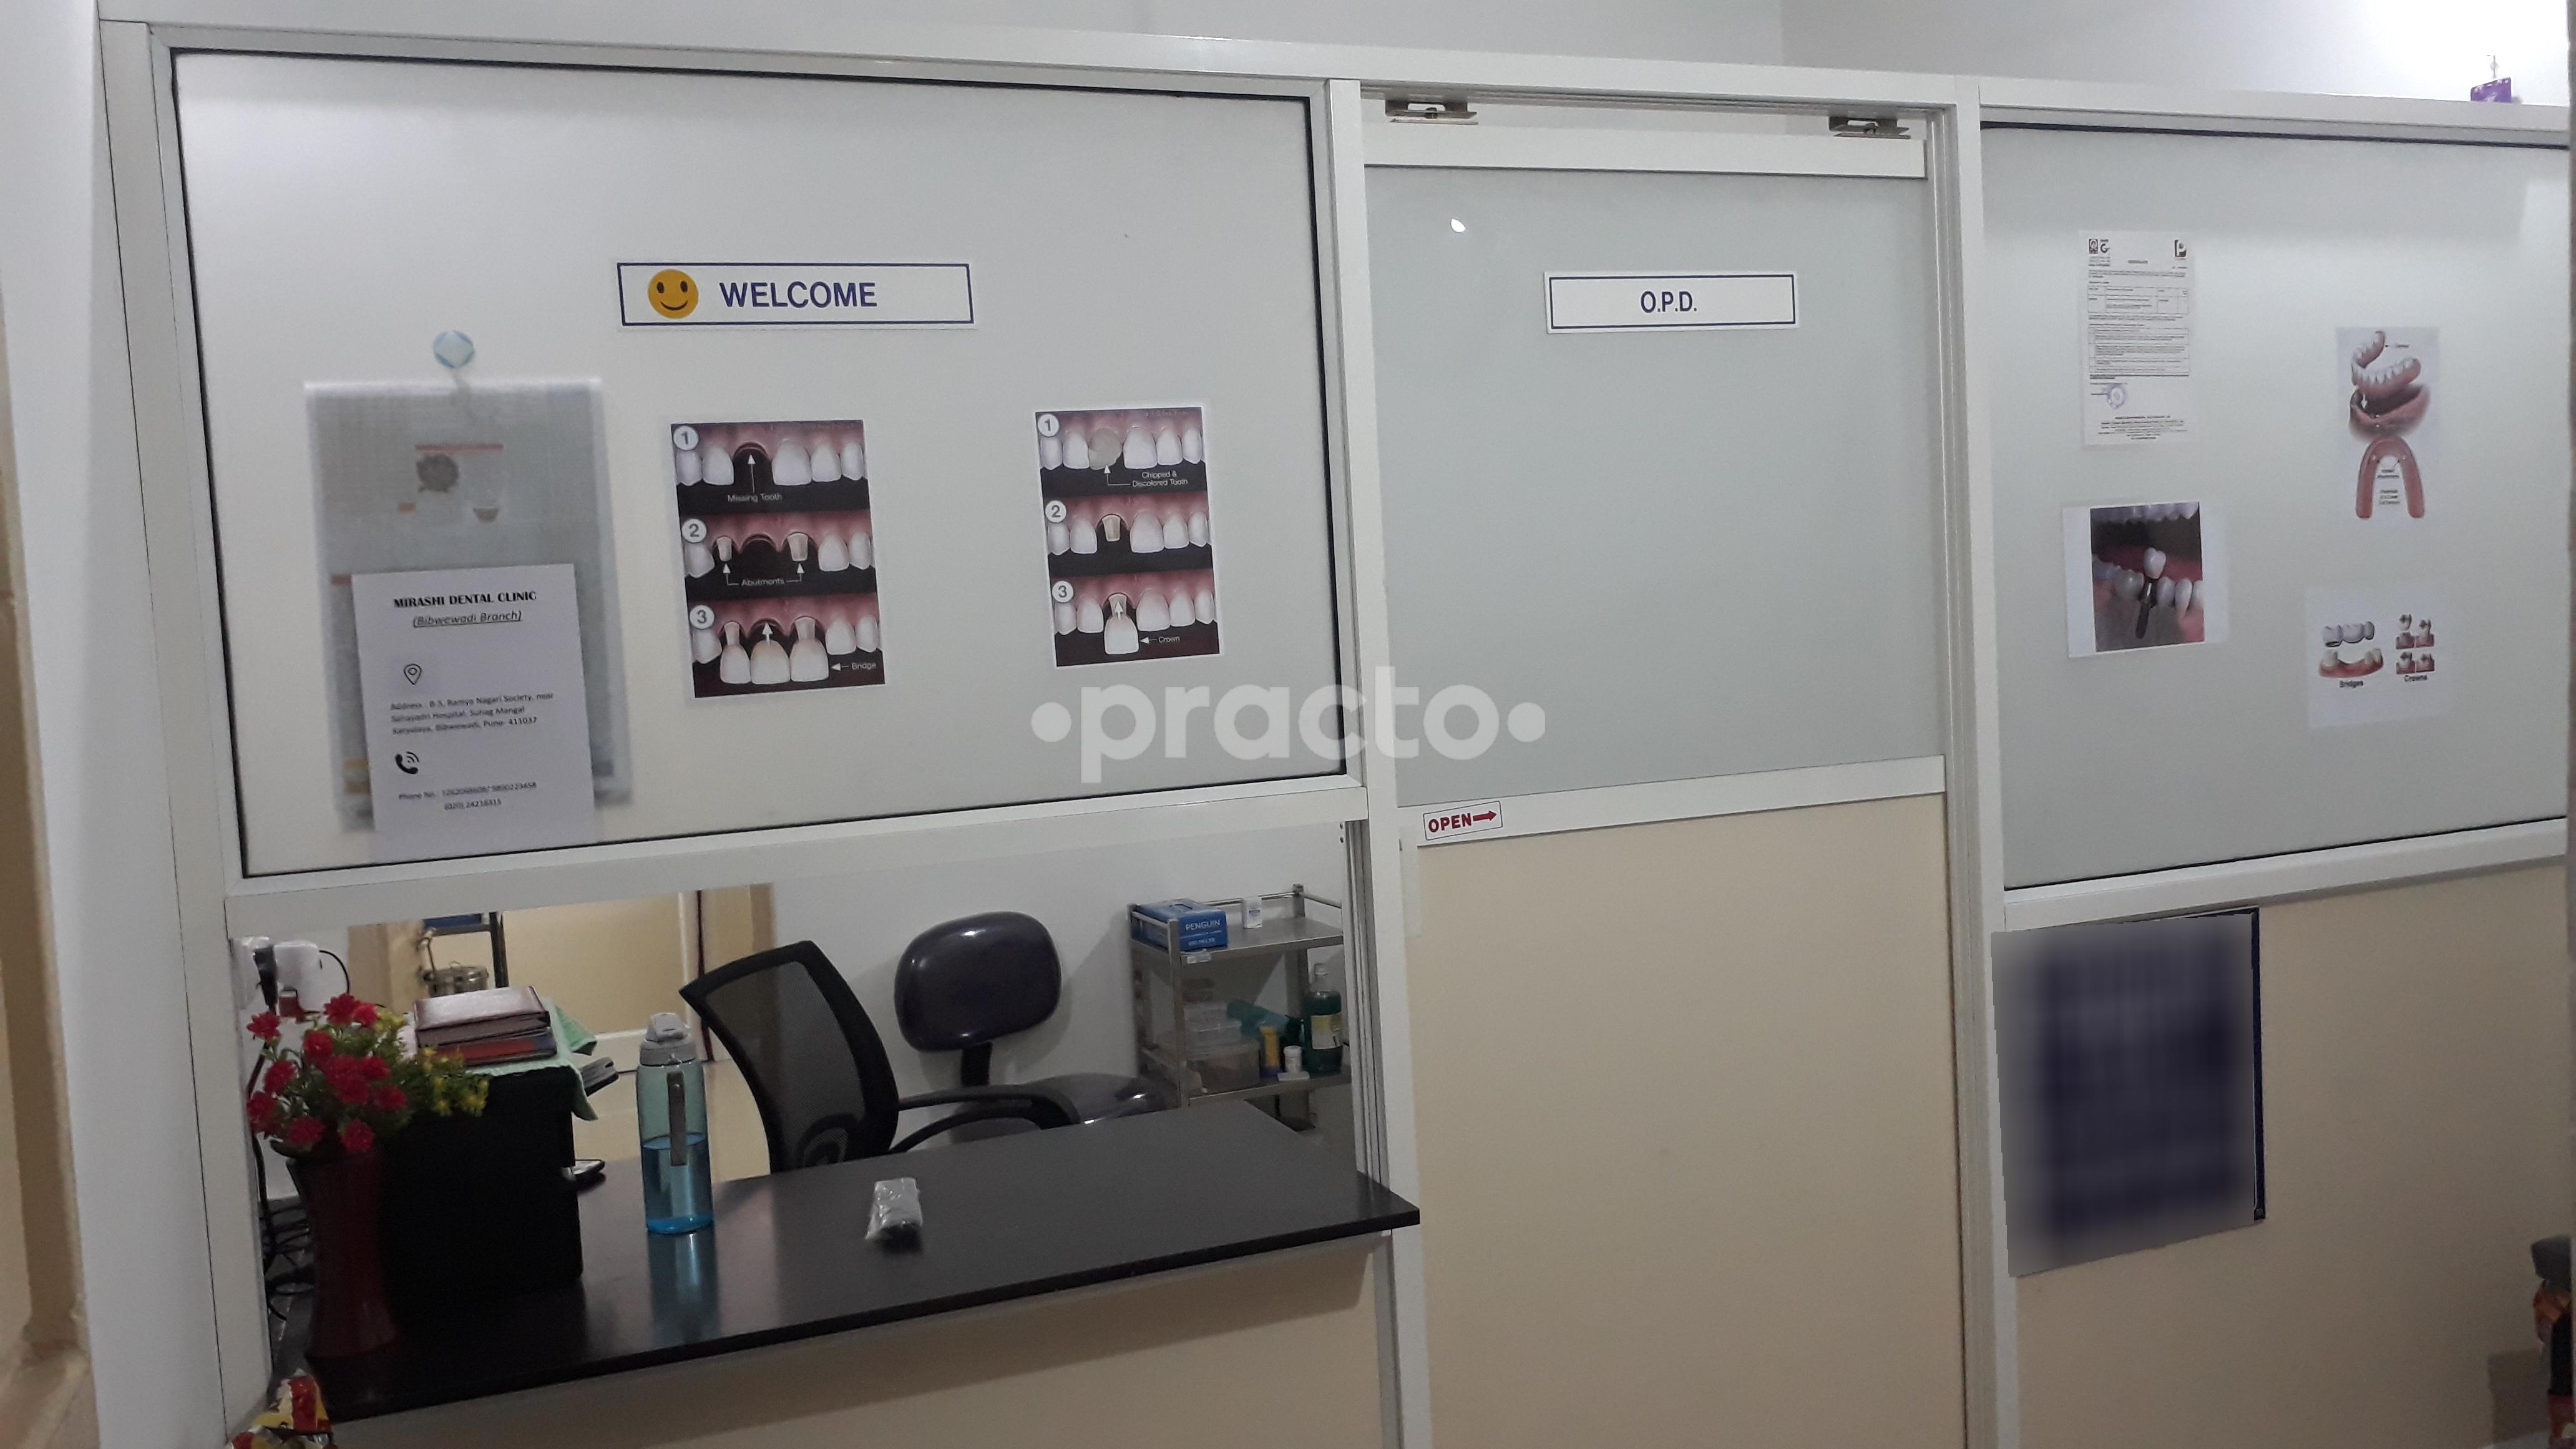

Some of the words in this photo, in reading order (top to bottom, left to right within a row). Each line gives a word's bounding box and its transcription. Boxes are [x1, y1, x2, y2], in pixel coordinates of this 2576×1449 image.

[719, 281, 877, 308] WELCOME
[1641, 291, 1697, 313] O.P.D.
[1044, 419, 1052, 431] 1
[681, 432, 689, 444] 1
[1051, 505, 1060, 517] 2
[689, 525, 699, 537] 2
[1058, 586, 1067, 597] 3
[394, 597, 444, 608] MIRASHI
[449, 593, 494, 605] DENTAL
[497, 591, 537, 602] CLINIC
[413, 614, 477, 626] (Bibwewadi
[480, 610, 522, 623] Branch)
[696, 610, 706, 623] 3
[1428, 813, 1471, 832] OPEN
[1186, 919, 1221, 930] PENGUIN
